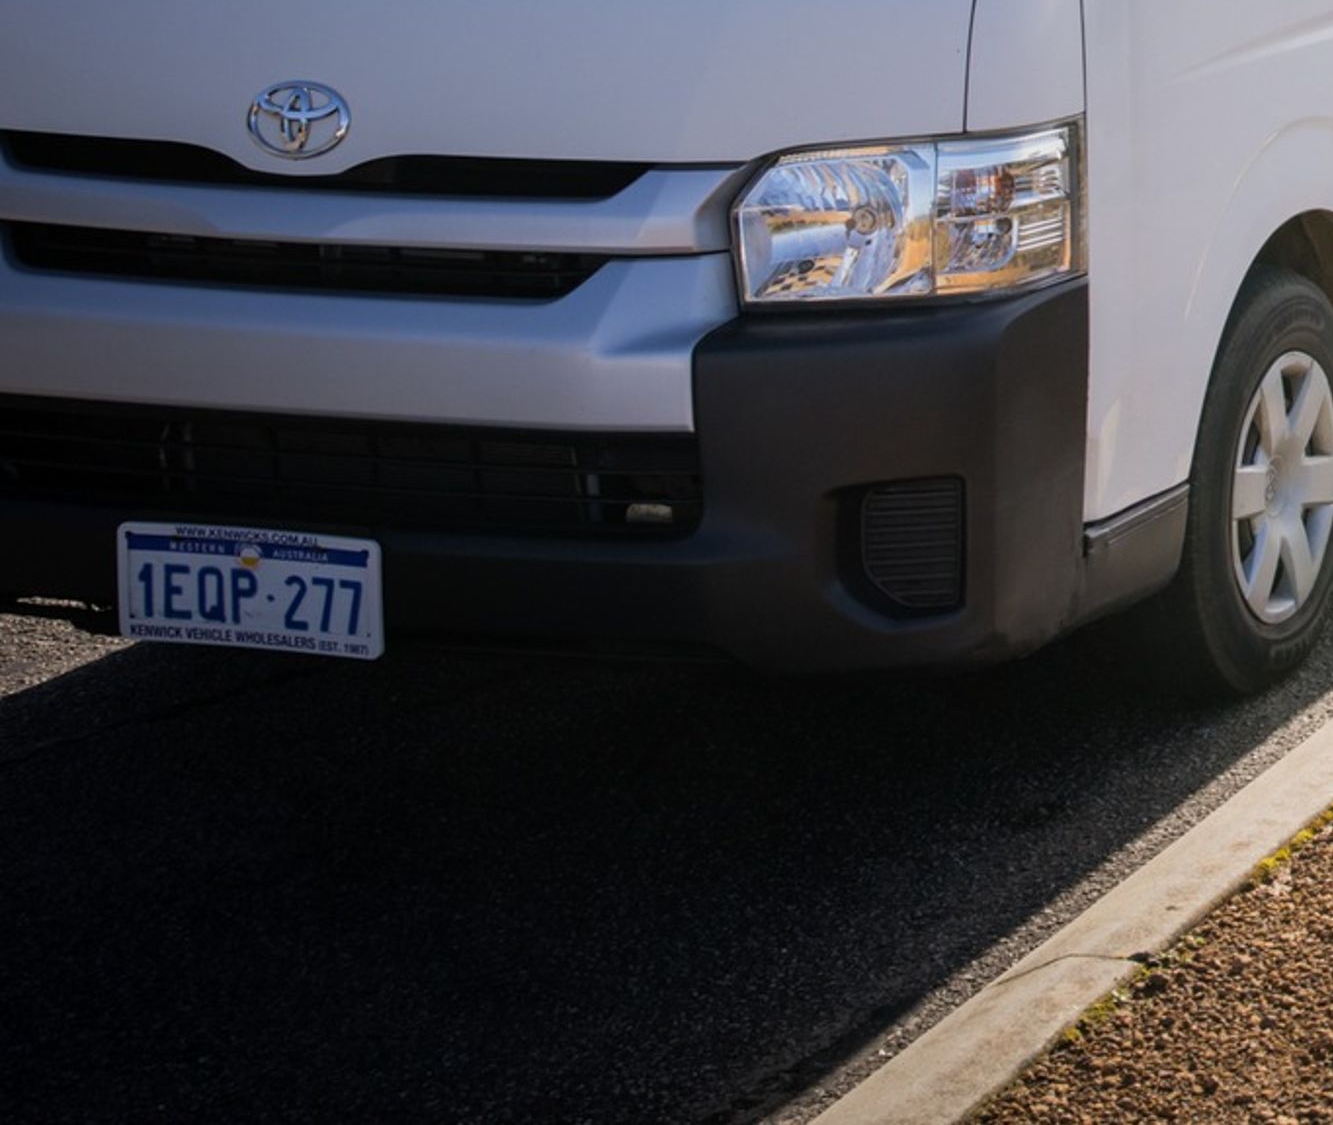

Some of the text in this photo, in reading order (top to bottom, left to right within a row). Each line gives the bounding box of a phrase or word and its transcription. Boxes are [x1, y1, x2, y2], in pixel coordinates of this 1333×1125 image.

[169, 541, 329, 562] WESTERN AUSTRALIA
[130, 624, 183, 639] KENWICK
[186, 627, 232, 642] VEHICLE
[235, 631, 316, 650] WHOLESALERS
